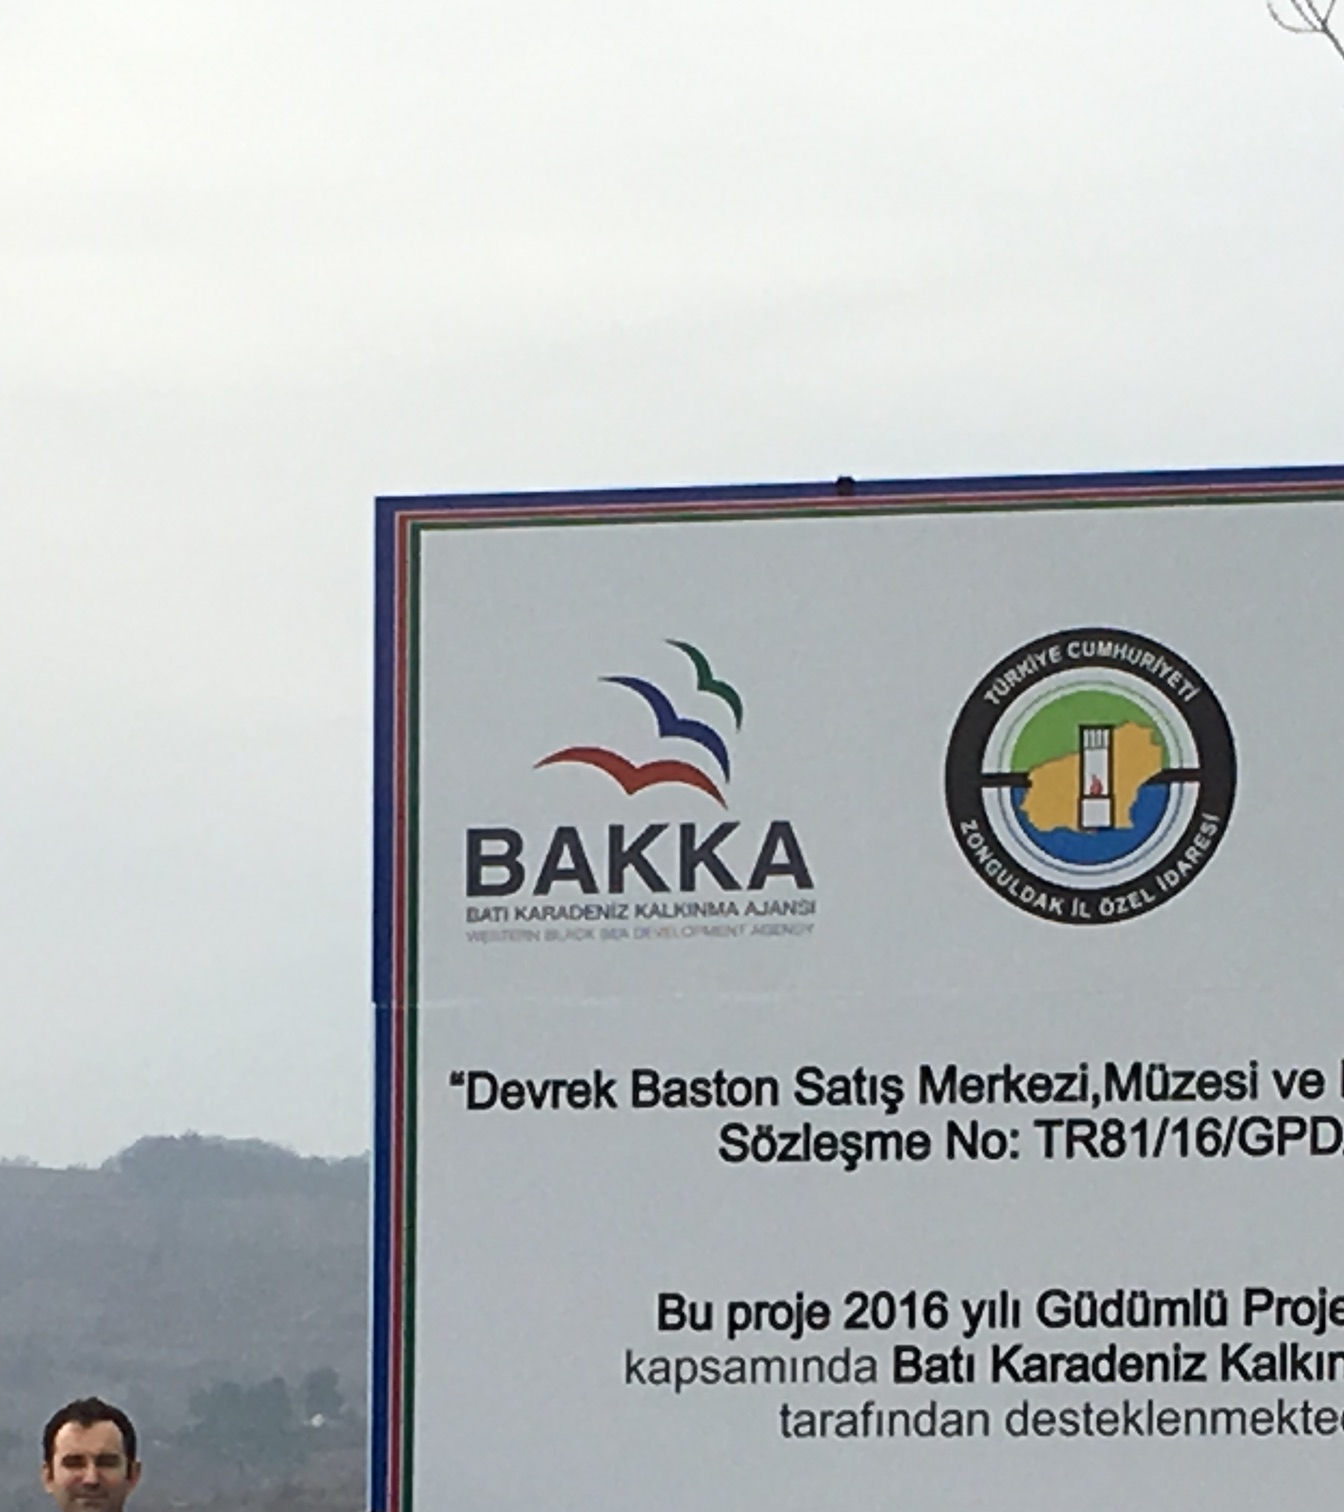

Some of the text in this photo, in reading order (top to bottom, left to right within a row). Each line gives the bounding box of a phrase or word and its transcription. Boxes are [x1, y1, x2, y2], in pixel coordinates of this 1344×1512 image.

[984, 640, 1201, 706] TÜRKİYE CUMHURİYETİ
[465, 820, 816, 897] BAKKA
[960, 812, 1221, 919] ZONGULDAK İL ÖZEL İDARESİ
[466, 899, 817, 923] BATI KARADENİZ KALKINMA AJANSI
[631, 1067, 779, 1110] Baston
[794, 1065, 906, 1115] Satış
[1272, 1067, 1325, 1099] ve
[719, 1122, 932, 1172] Sözleşme
[946, 1119, 1021, 1161] No:
[657, 1293, 713, 1332] Bu
[727, 1291, 832, 1340] proje
[844, 1291, 949, 1330] 2016
[962, 1289, 1021, 1338] yılı
[1037, 1287, 1228, 1329] Güdümlü
[625, 1346, 879, 1394] kapsamında
[893, 1344, 975, 1384] Batı
[991, 1342, 1207, 1383] Karadeniz
[779, 1401, 989, 1438] tarafından
